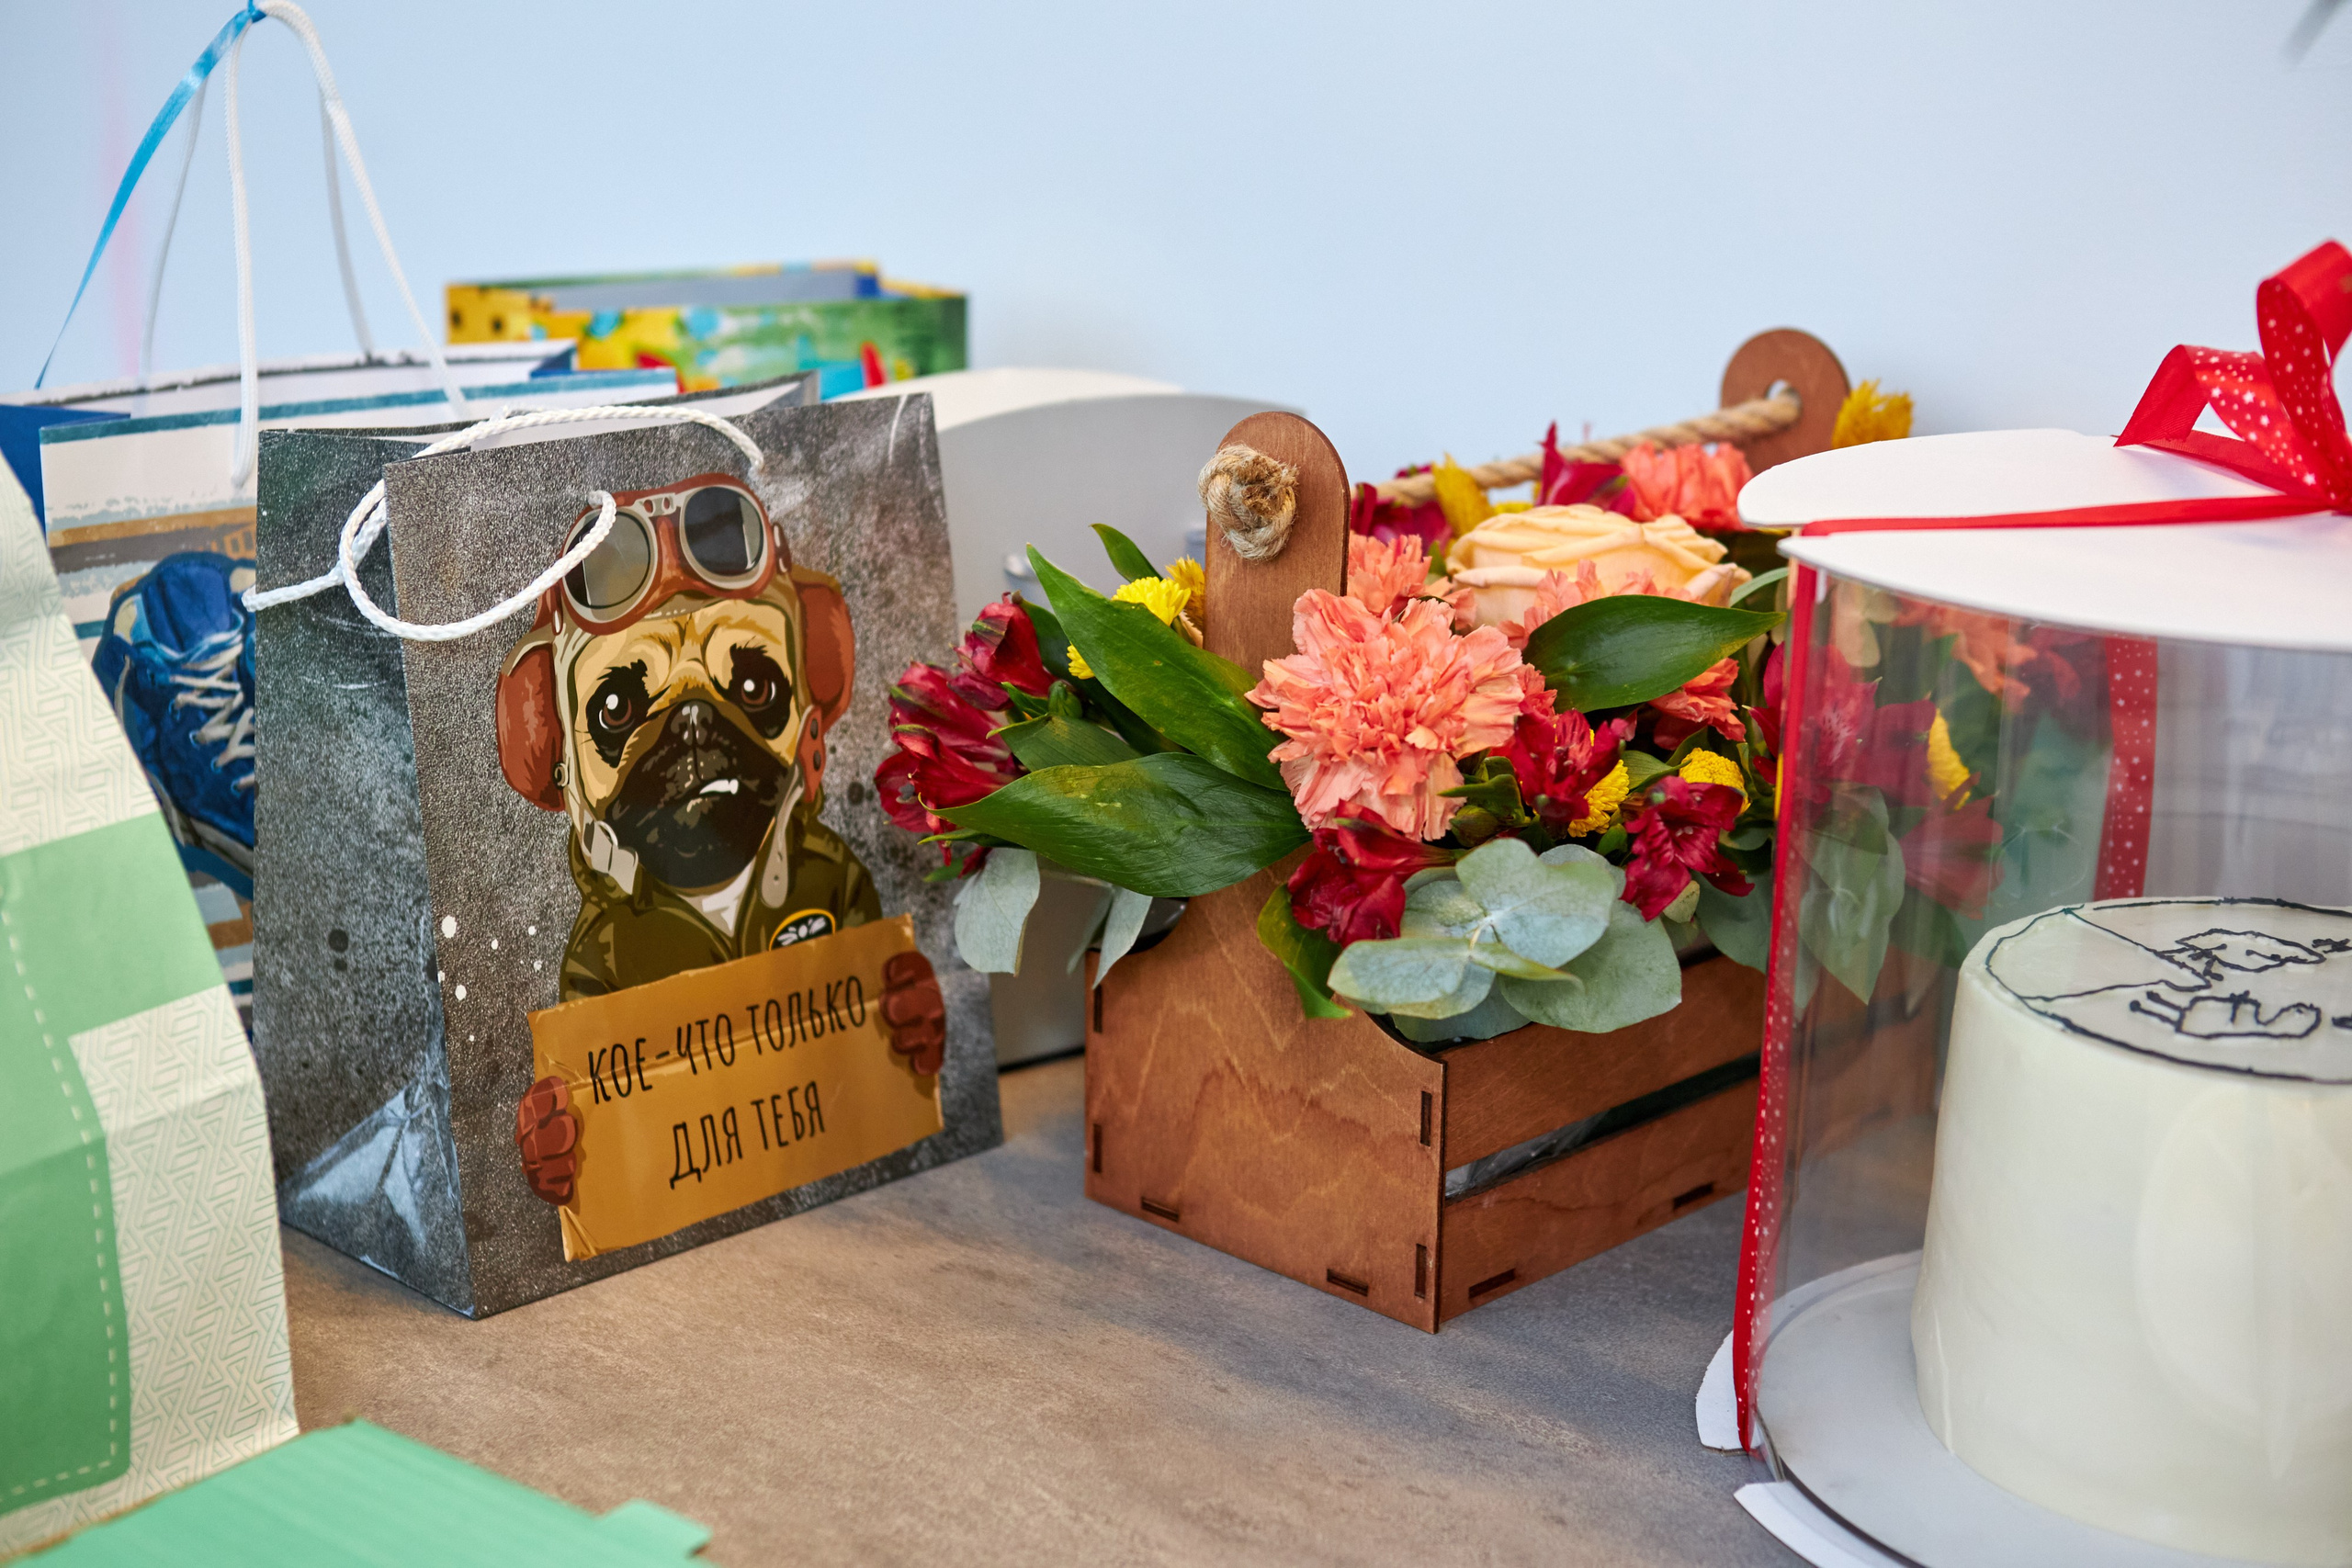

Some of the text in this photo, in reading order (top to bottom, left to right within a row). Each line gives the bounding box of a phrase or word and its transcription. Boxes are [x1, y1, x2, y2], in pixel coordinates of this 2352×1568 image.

[587, 975, 867, 1106] КОЕ-ЧТО ТОЛЬКО
[669, 1080, 826, 1190] ДЛЯ ТЕБЯ
